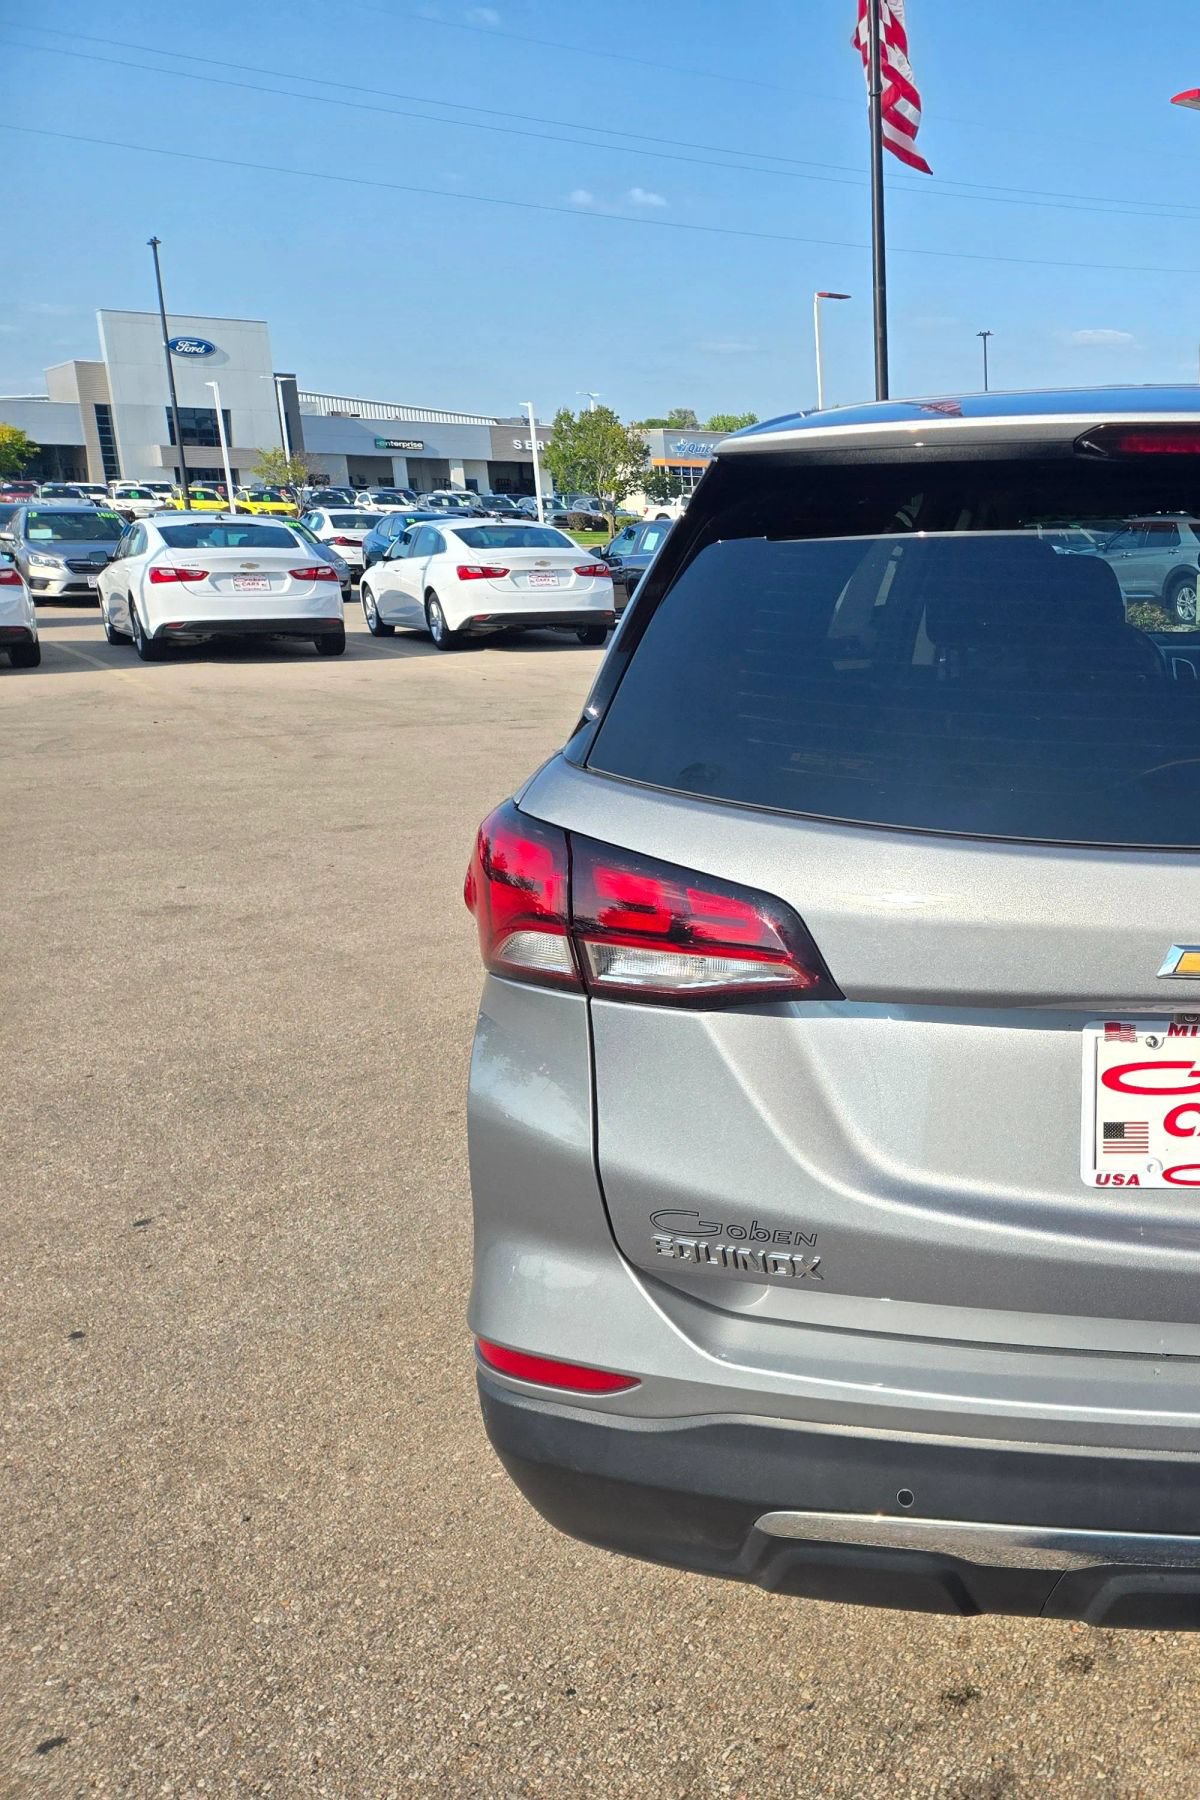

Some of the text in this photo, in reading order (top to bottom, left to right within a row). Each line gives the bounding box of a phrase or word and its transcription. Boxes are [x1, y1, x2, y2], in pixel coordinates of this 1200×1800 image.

[176, 340, 206, 353] Ford
[1095, 1173, 1140, 1186] USA
[651, 1233, 824, 1280] EQUINOX
